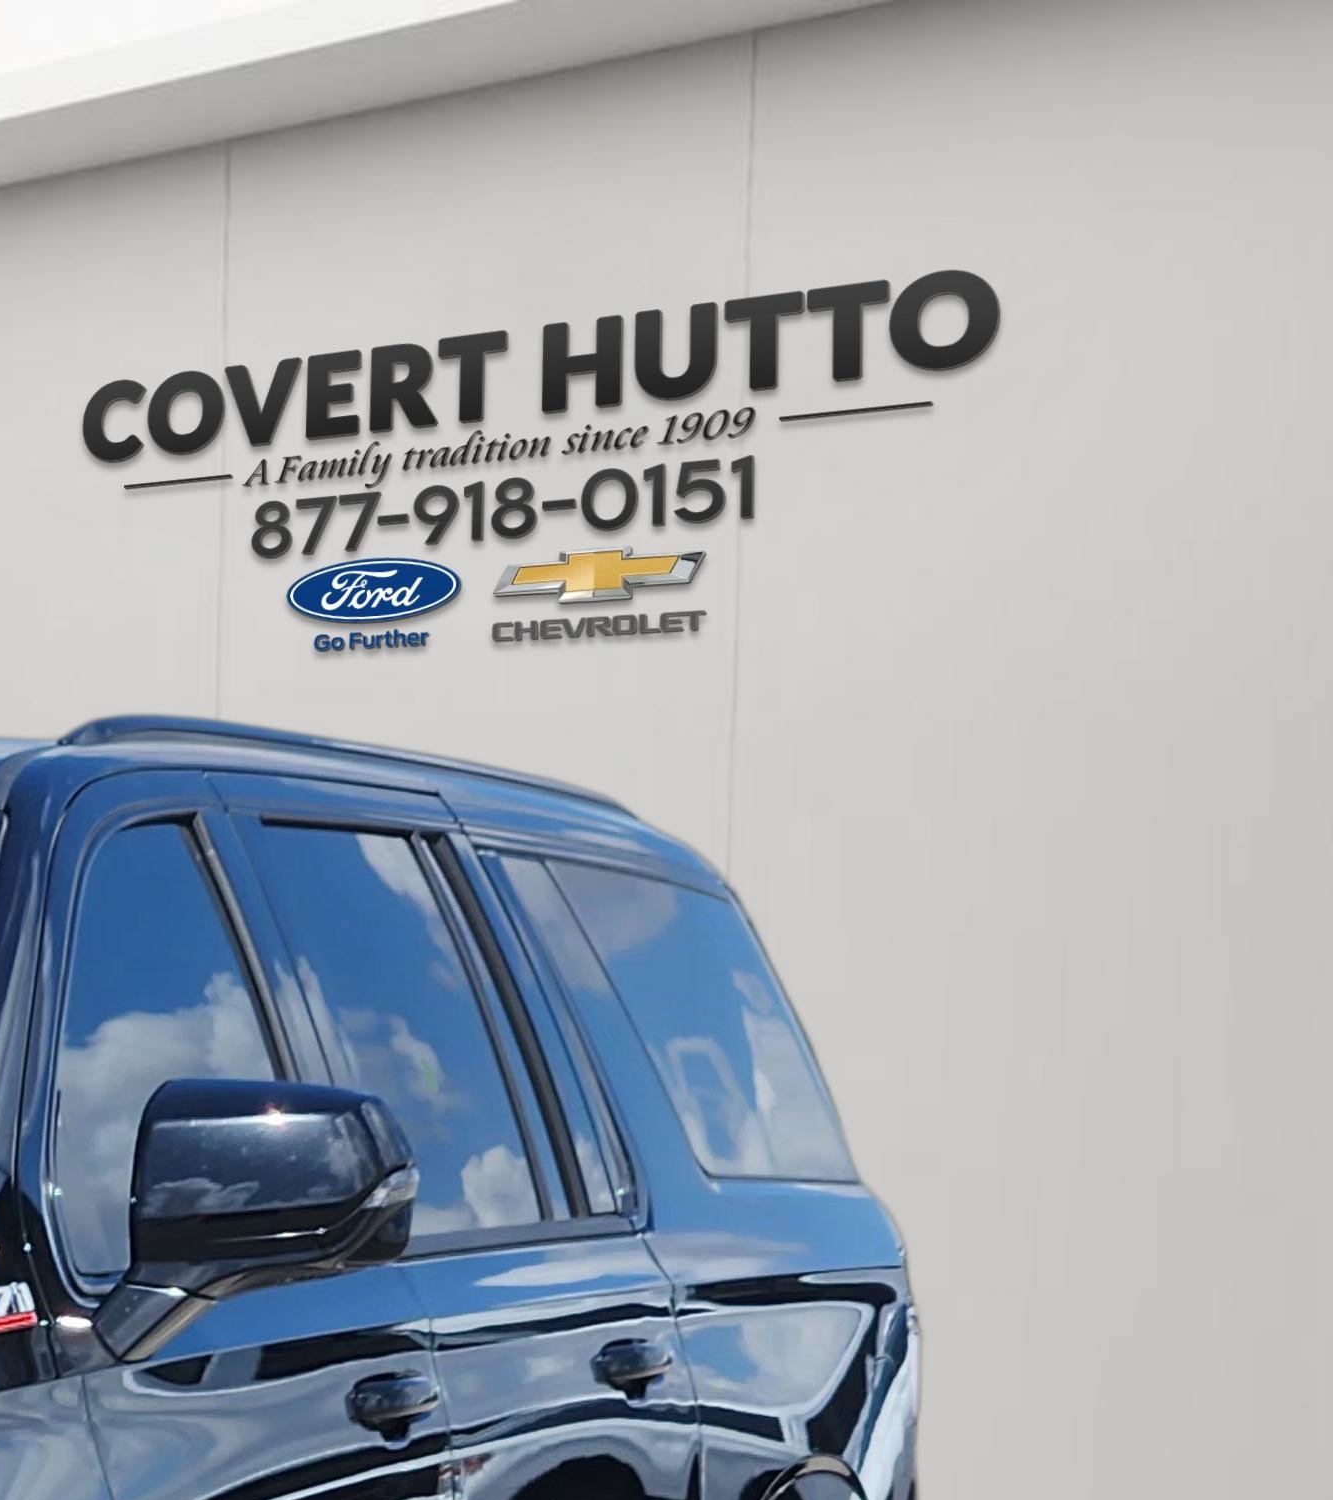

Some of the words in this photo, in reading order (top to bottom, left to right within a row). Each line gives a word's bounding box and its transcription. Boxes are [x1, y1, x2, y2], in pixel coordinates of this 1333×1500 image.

[82, 329, 509, 465] COVERT
[541, 269, 1001, 416] HUTTO
[242, 458, 270, 488] A
[275, 440, 393, 490] Family
[402, 430, 552, 474] tradition
[561, 425, 650, 456] since
[657, 406, 756, 446] 1909
[250, 454, 755, 560] 877-918-0151
[320, 569, 422, 612] Ford
[313, 633, 346, 653] Go
[348, 628, 430, 651] Further
[491, 610, 707, 644] CHEVROLET
